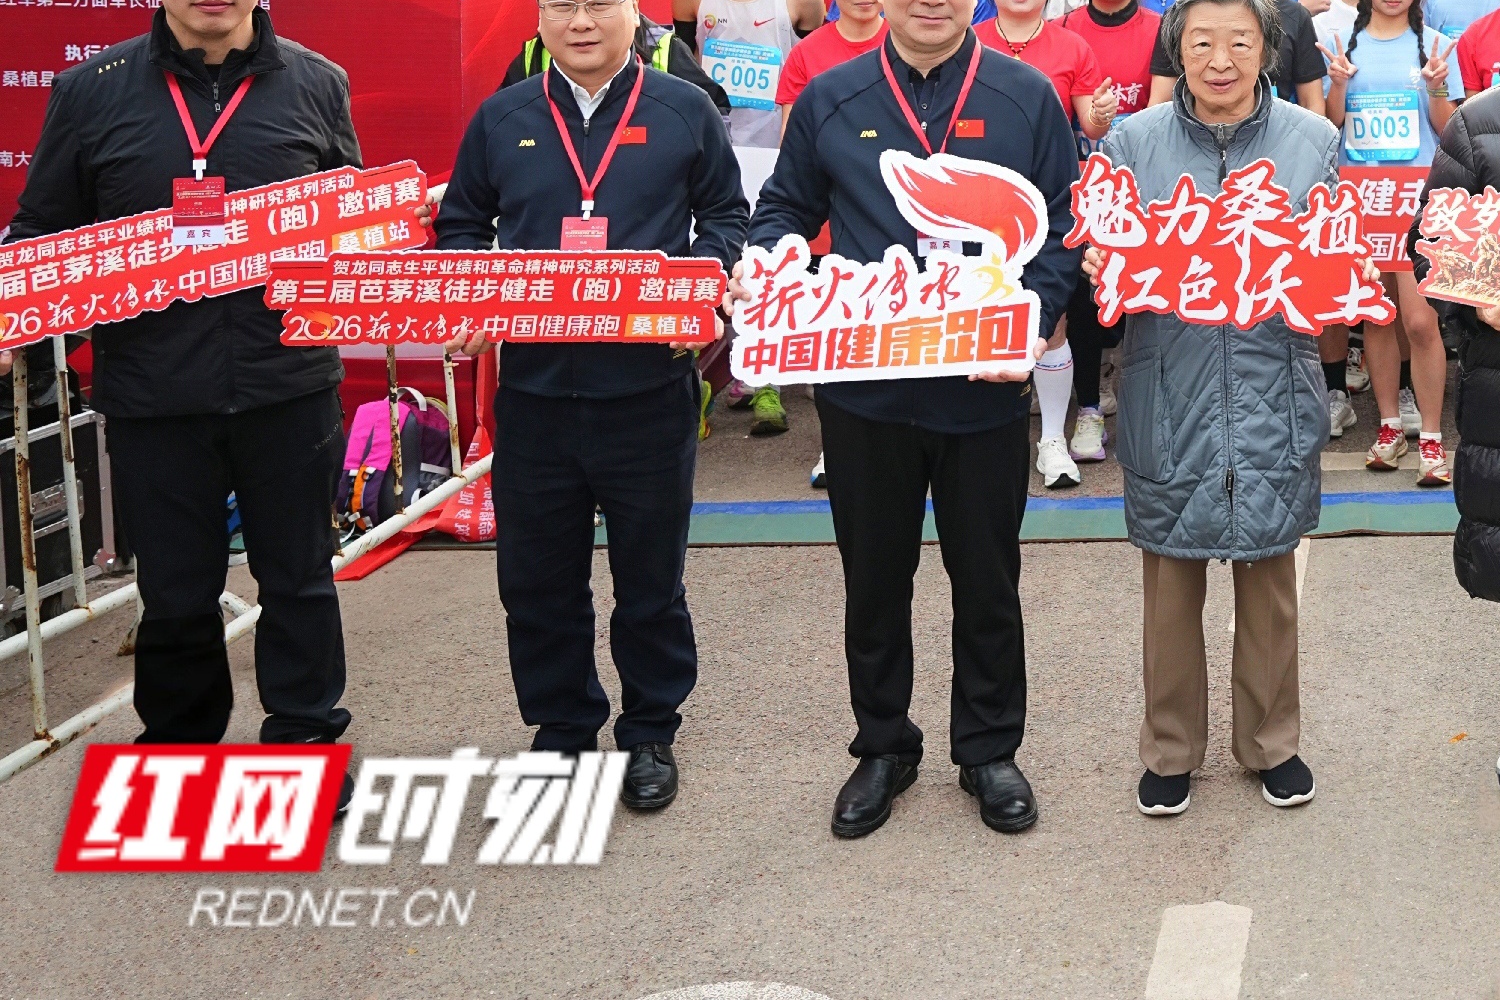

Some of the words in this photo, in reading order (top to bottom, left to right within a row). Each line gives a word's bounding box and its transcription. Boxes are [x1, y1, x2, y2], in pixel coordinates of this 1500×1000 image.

[98, 58, 126, 74] ANTA
[1070, 159, 1368, 258] 魅力桑植
[336, 219, 411, 255] 桑植站
[332, 258, 661, 277] 贺龙同志生平业绩和革命精神研究系列活动
[270, 276, 722, 306] 第三届芭茅溪徒步健走（跑）邀请赛
[1099, 249, 1391, 331] 红色沃土
[631, 315, 701, 336] 桑植站
[742, 302, 1031, 375] 中国健康跑
